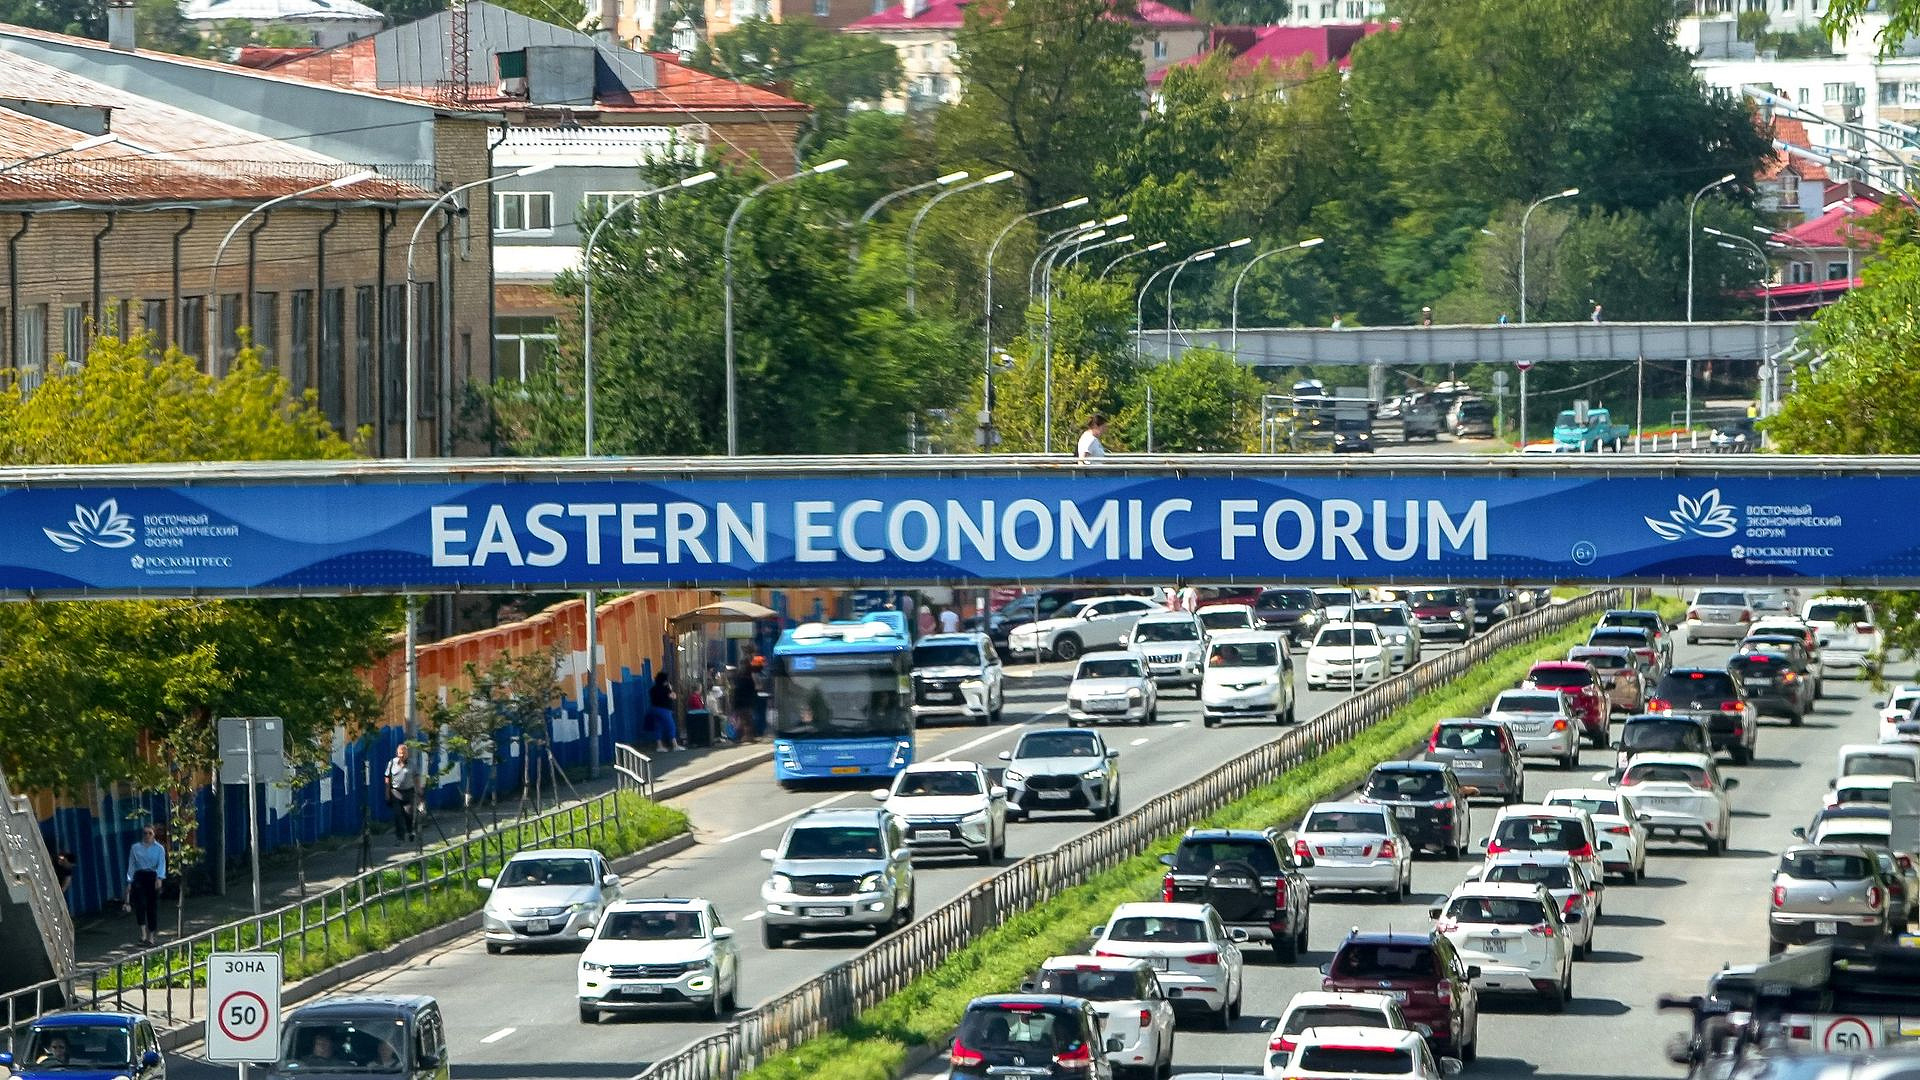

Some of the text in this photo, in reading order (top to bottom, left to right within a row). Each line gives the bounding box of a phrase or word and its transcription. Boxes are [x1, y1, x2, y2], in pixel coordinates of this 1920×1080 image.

[1746, 504, 1812, 515] ВОСТОЧНЫЙ
[143, 514, 208, 525] ВОСТОЧНЫЙ
[1746, 515, 1841, 526] ЭКОНОМИЧЕСКИЙ
[144, 525, 239, 537] ЭКОНОМИЧЕСКИЙ
[430, 498, 1488, 568] EASTERN ECONOMIC FORUM
[1746, 528, 1786, 538] ФОРУМ
[144, 538, 183, 547] ФОРУМ
[1576, 547, 1591, 559] 6+
[144, 556, 232, 567] РОСКОНГРЕСС
[225, 961, 265, 973] ЗОНА
[231, 1006, 256, 1025] 50
[1835, 1032, 1861, 1051] 50
